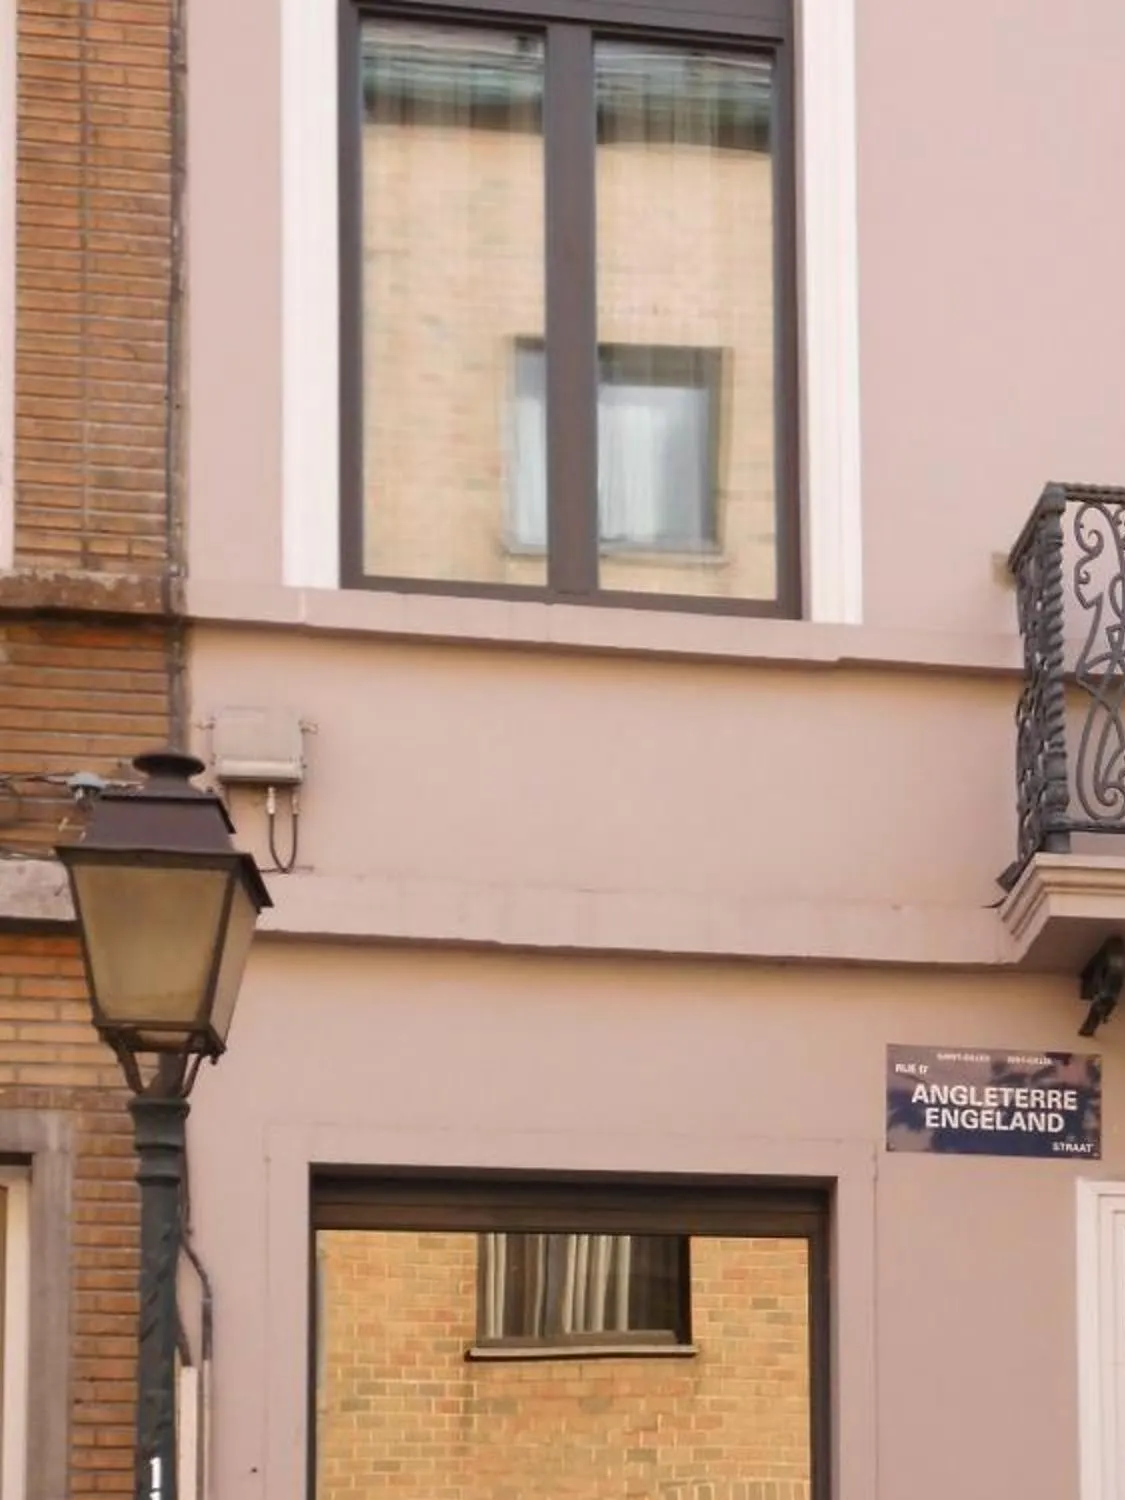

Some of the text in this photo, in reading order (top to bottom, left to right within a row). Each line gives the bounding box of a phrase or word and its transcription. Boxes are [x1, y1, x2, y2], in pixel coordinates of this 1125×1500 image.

[911, 1084, 1078, 1111] ANGLETERRE
[925, 1107, 1065, 1132] ENGELAND
[1052, 1142, 1094, 1152] STRAAT
